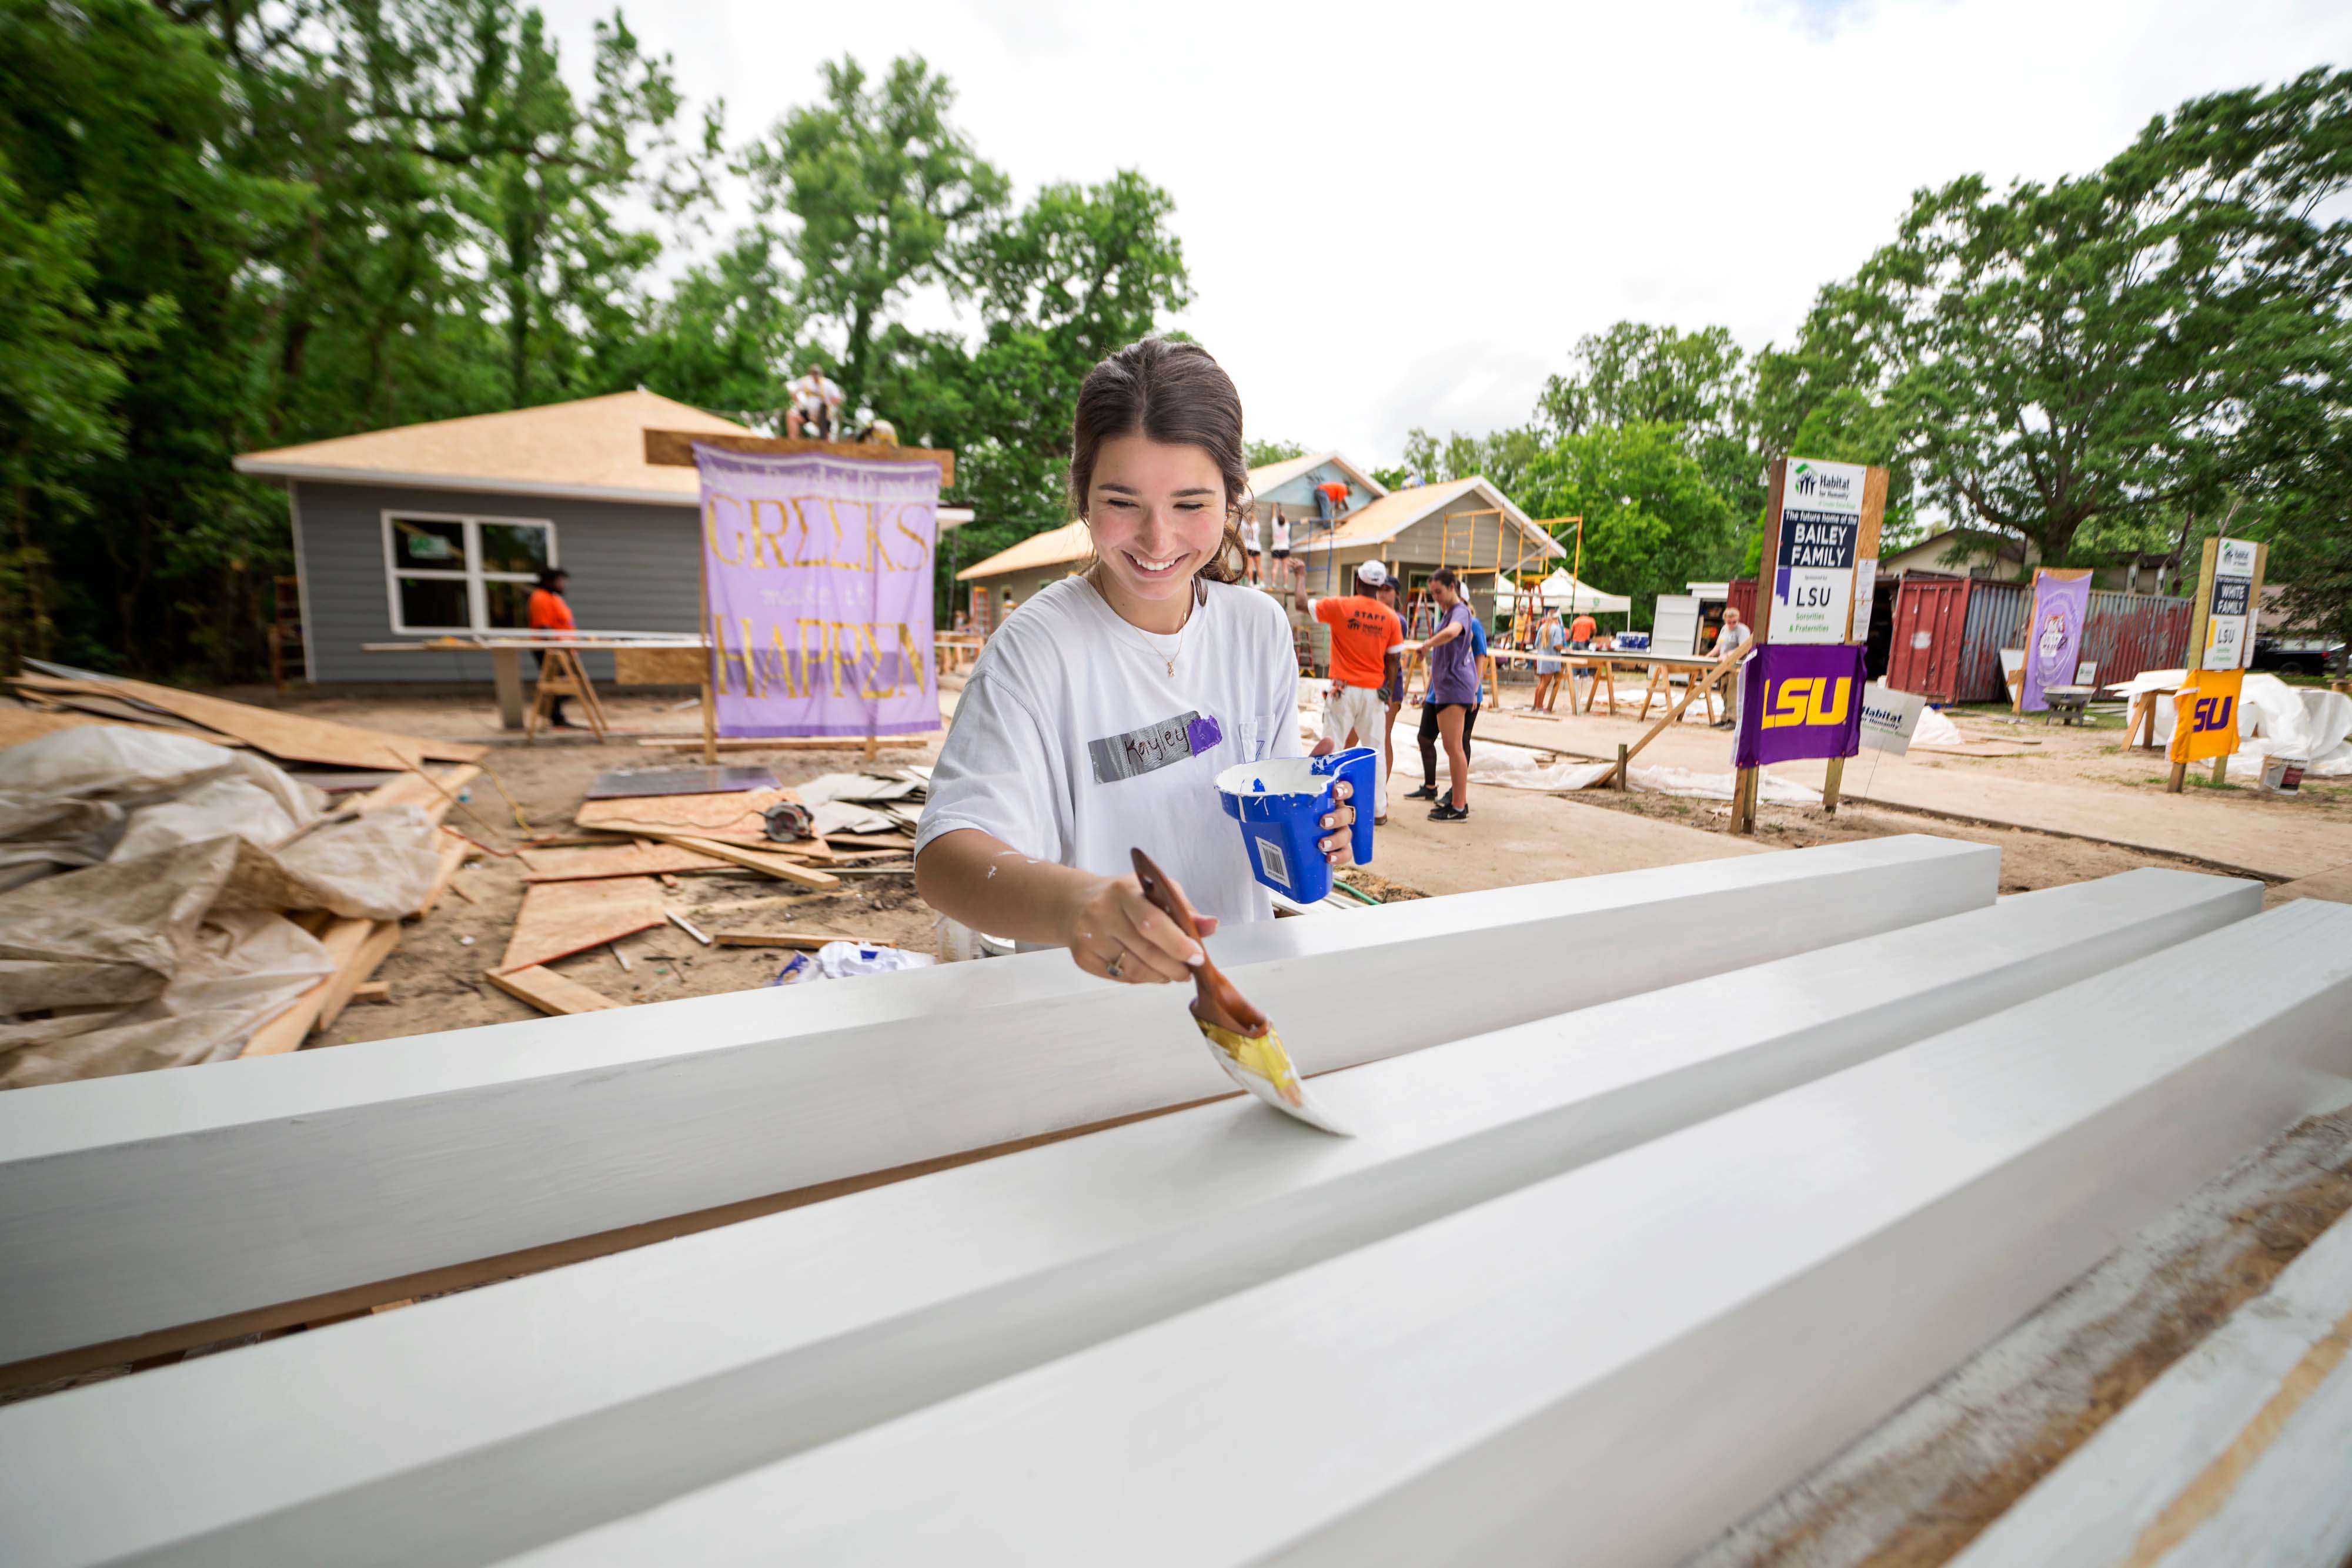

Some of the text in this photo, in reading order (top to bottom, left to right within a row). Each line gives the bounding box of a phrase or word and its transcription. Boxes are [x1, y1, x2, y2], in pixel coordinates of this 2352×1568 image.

[1820, 473, 1849, 490] Habitat
[1785, 509, 1858, 526] The future home of the
[1794, 523, 1847, 546] BAILEY
[1790, 544, 1846, 567] FAMILY
[1796, 586, 1832, 608] LSU
[2221, 583, 2246, 600] WHITE
[1355, 610, 1387, 621] STAFF
[2217, 599, 2244, 615] FAMILY
[2217, 628, 2236, 644] LSU
[1761, 676, 1852, 731] LSU
[2193, 696, 2233, 733] SU
[1124, 726, 1190, 765] Kayley
